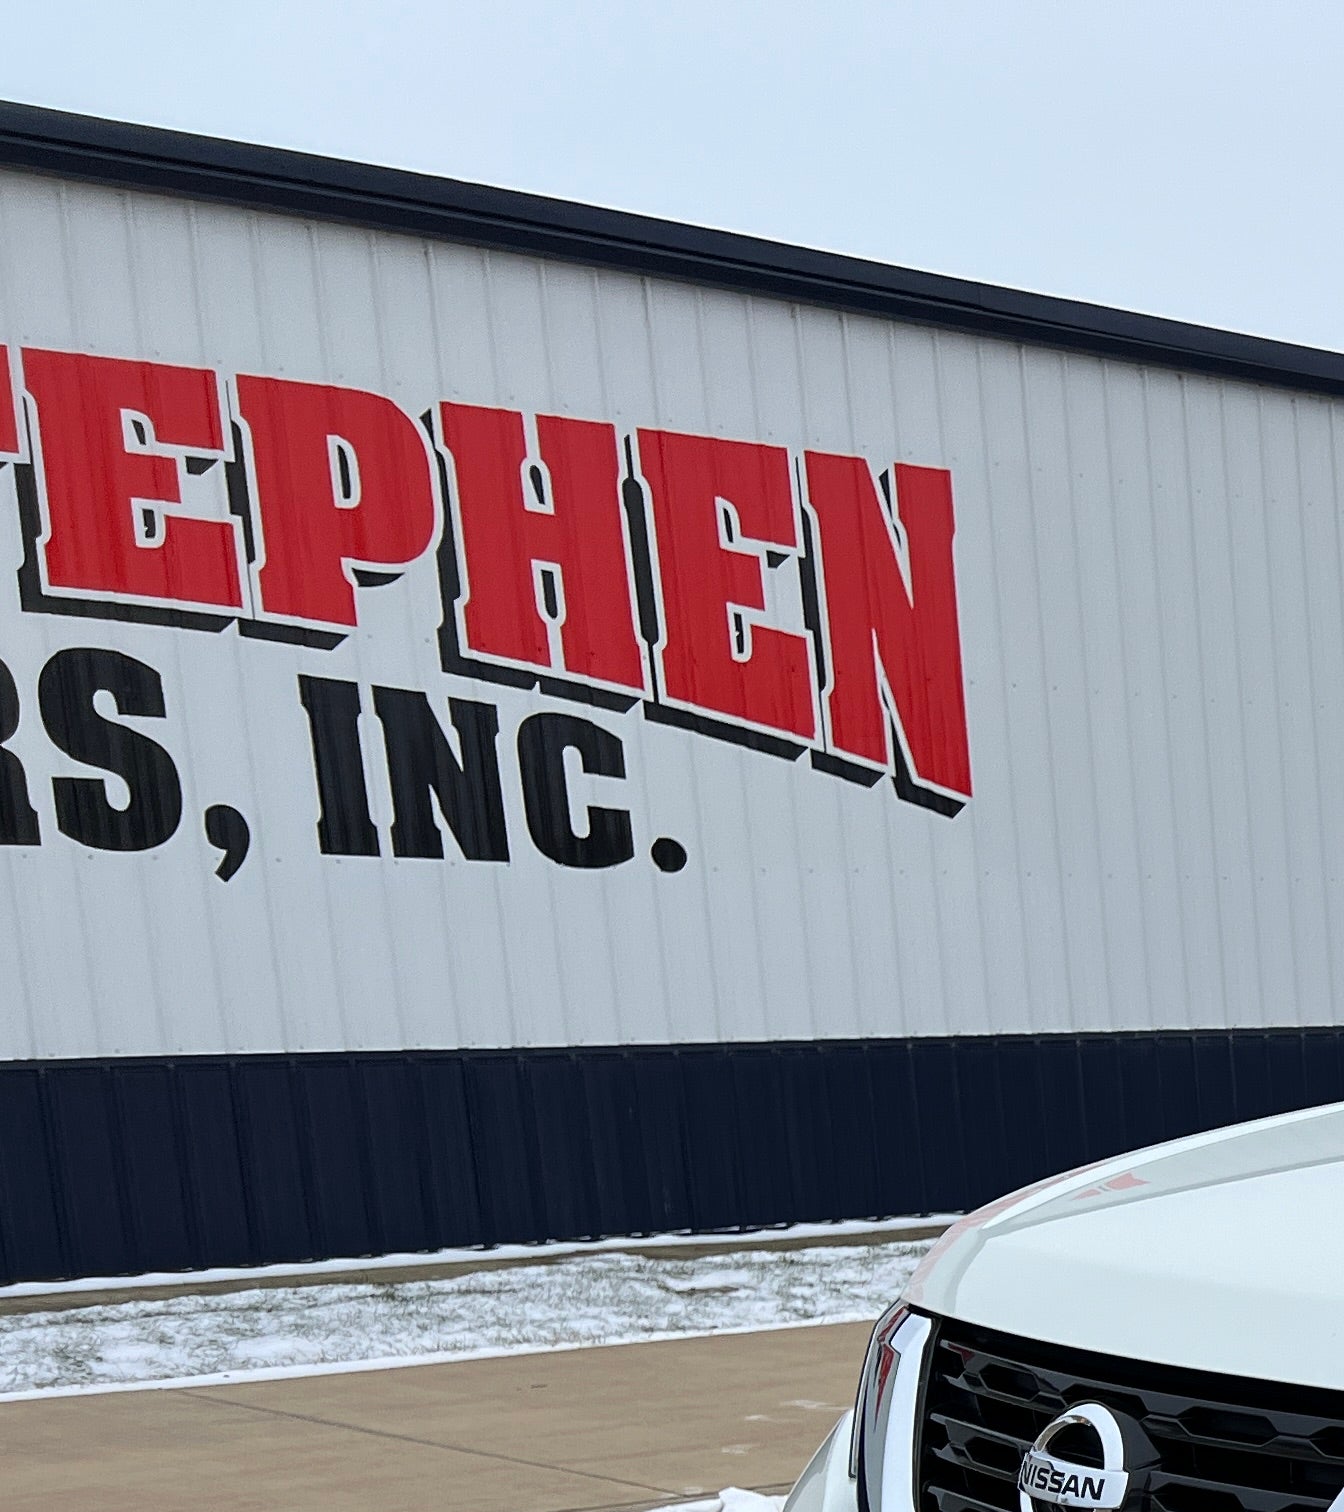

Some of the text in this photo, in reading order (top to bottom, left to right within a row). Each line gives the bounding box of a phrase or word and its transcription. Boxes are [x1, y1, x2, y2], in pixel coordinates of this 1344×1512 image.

[0, 344, 975, 819] EPHEN
[297, 673, 688, 873] INC.
[1020, 1460, 1106, 1501] NISSAN
